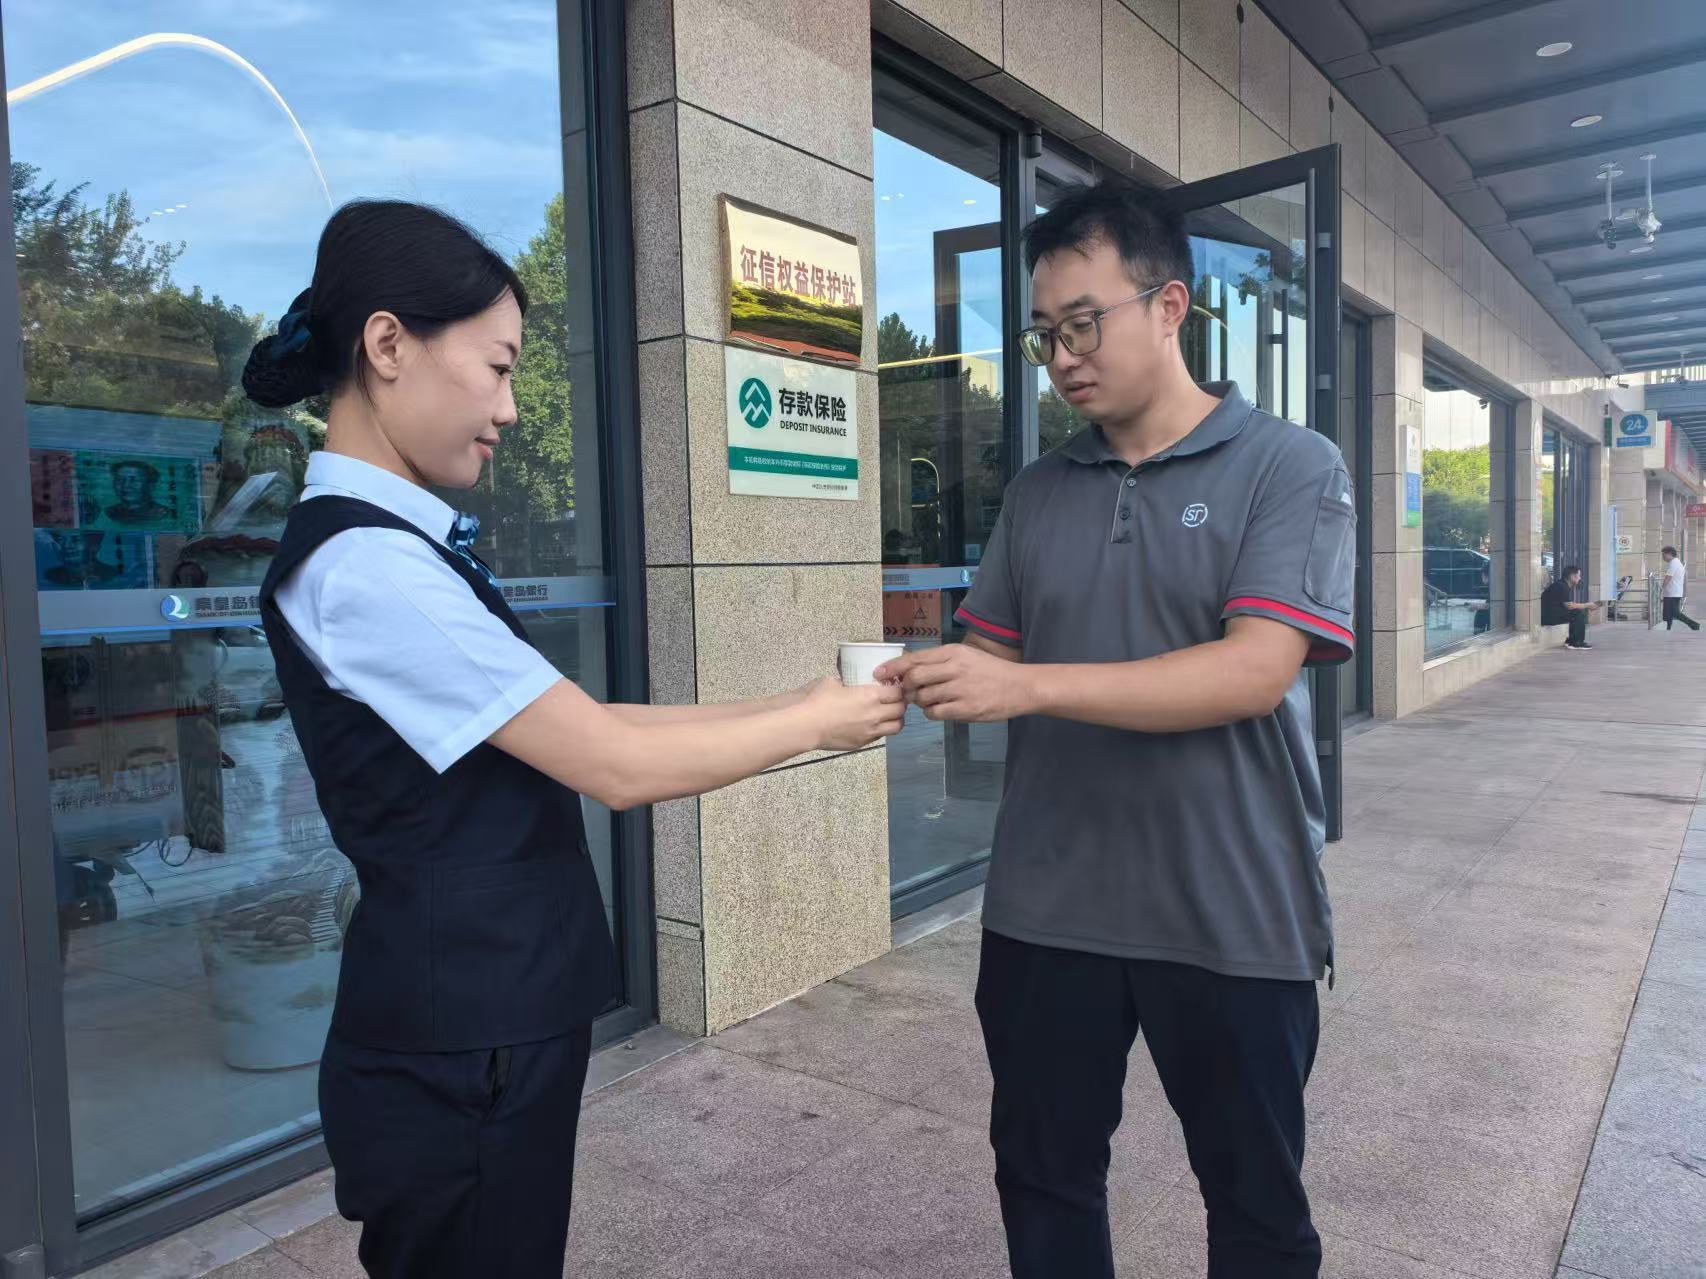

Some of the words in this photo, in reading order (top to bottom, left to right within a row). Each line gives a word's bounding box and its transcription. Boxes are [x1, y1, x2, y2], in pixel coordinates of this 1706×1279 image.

[740, 244, 856, 307] 征信权益保护站
[778, 388, 847, 422] 存款保险
[780, 420, 808, 432] DEPOSIT
[809, 424, 847, 437] INSURANCE
[1626, 418, 1643, 431] 24
